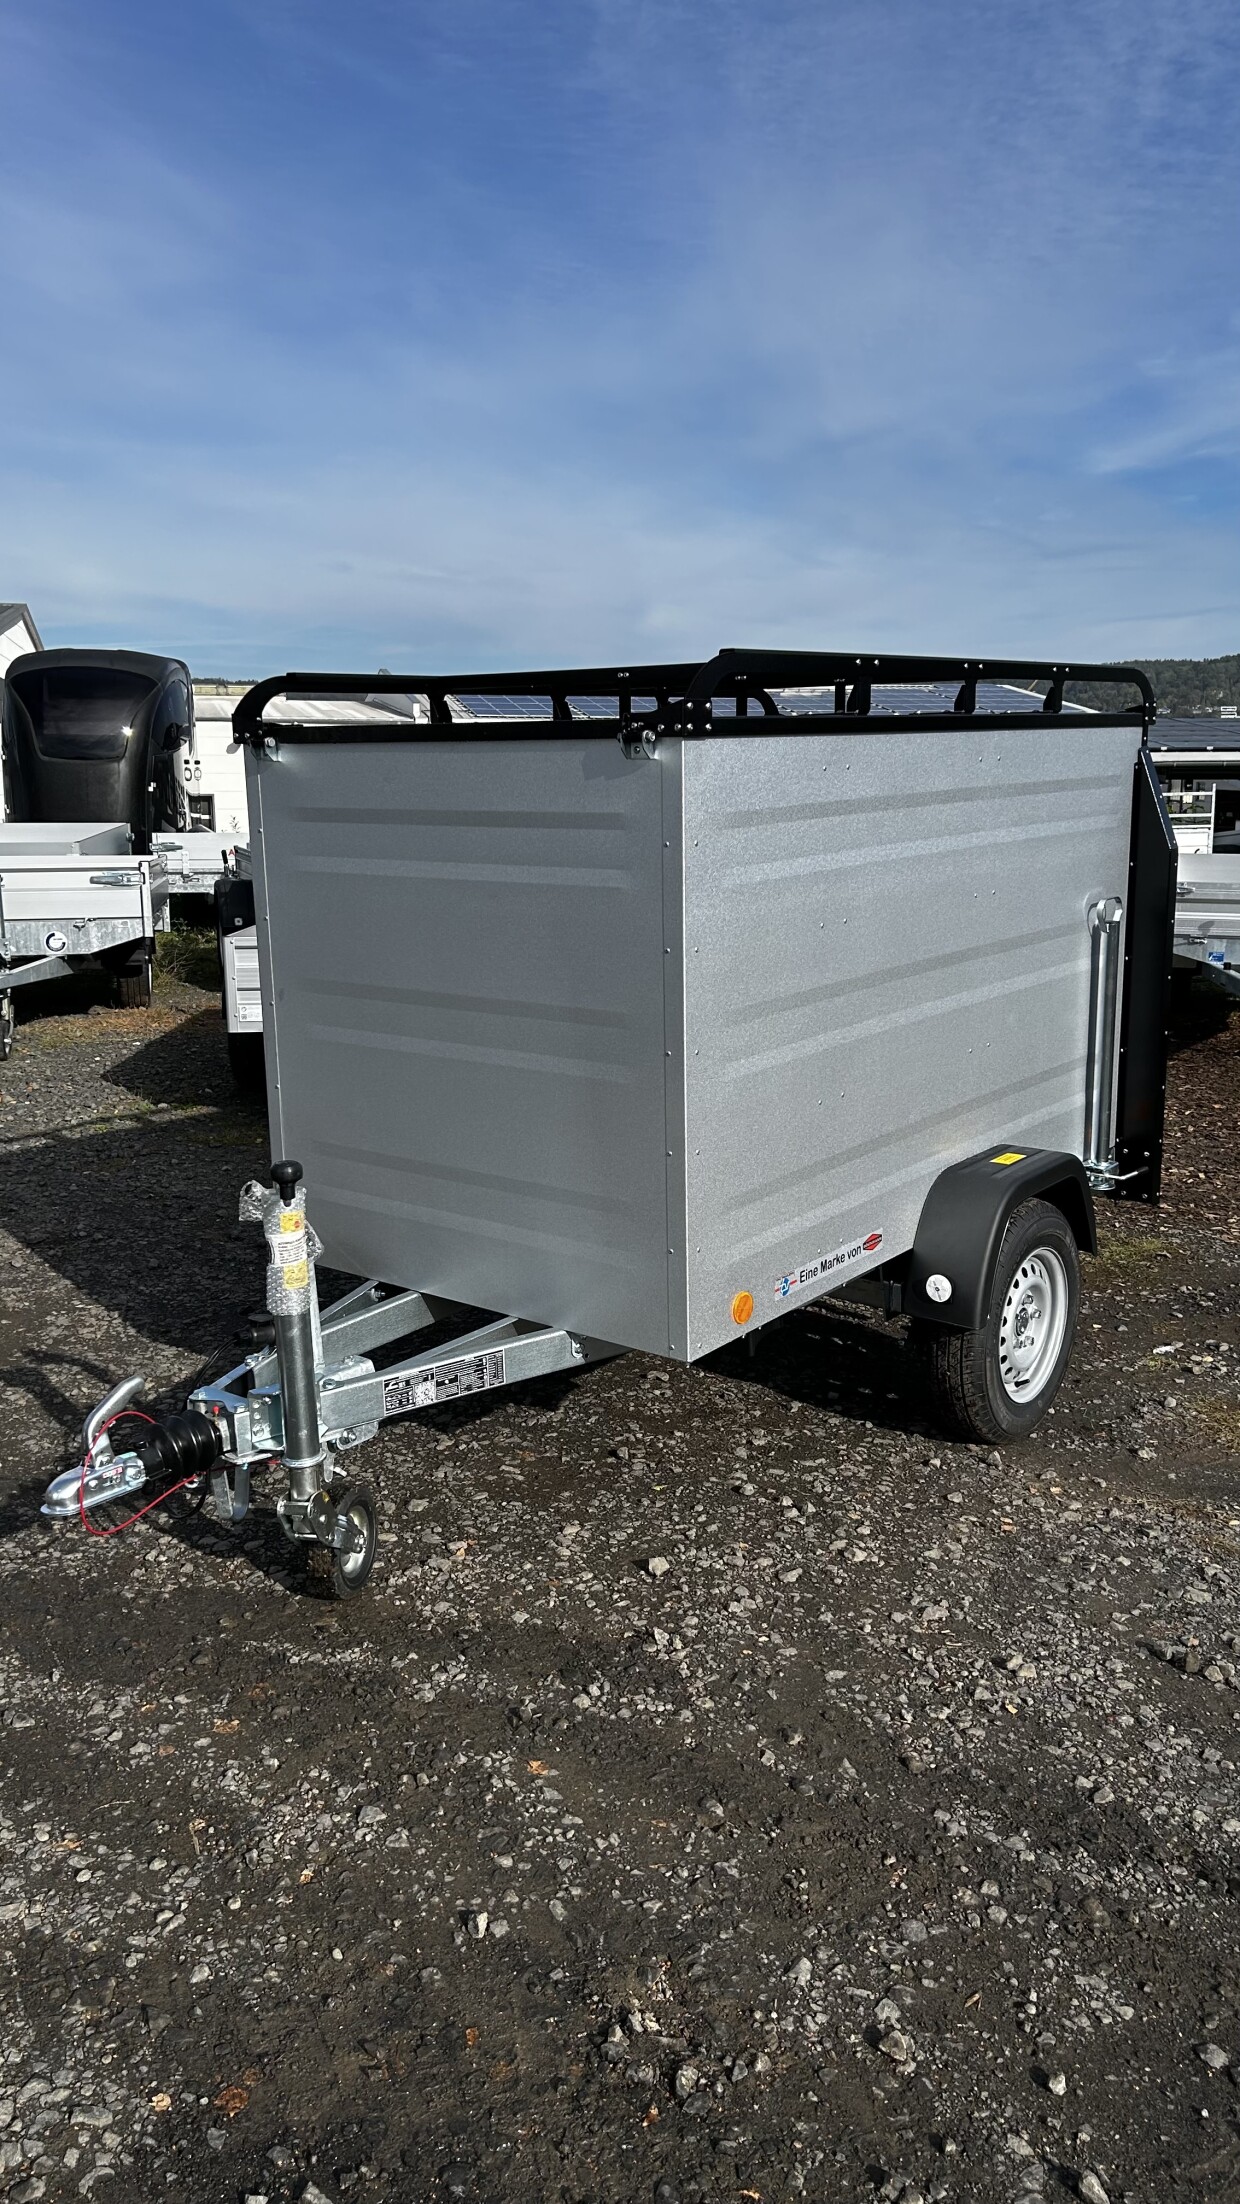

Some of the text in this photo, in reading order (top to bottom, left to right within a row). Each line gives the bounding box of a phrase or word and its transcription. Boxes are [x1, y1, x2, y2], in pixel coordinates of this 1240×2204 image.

[799, 1266, 818, 1283] Eine
[820, 1253, 846, 1273] Marke
[847, 1245, 862, 1260] von
